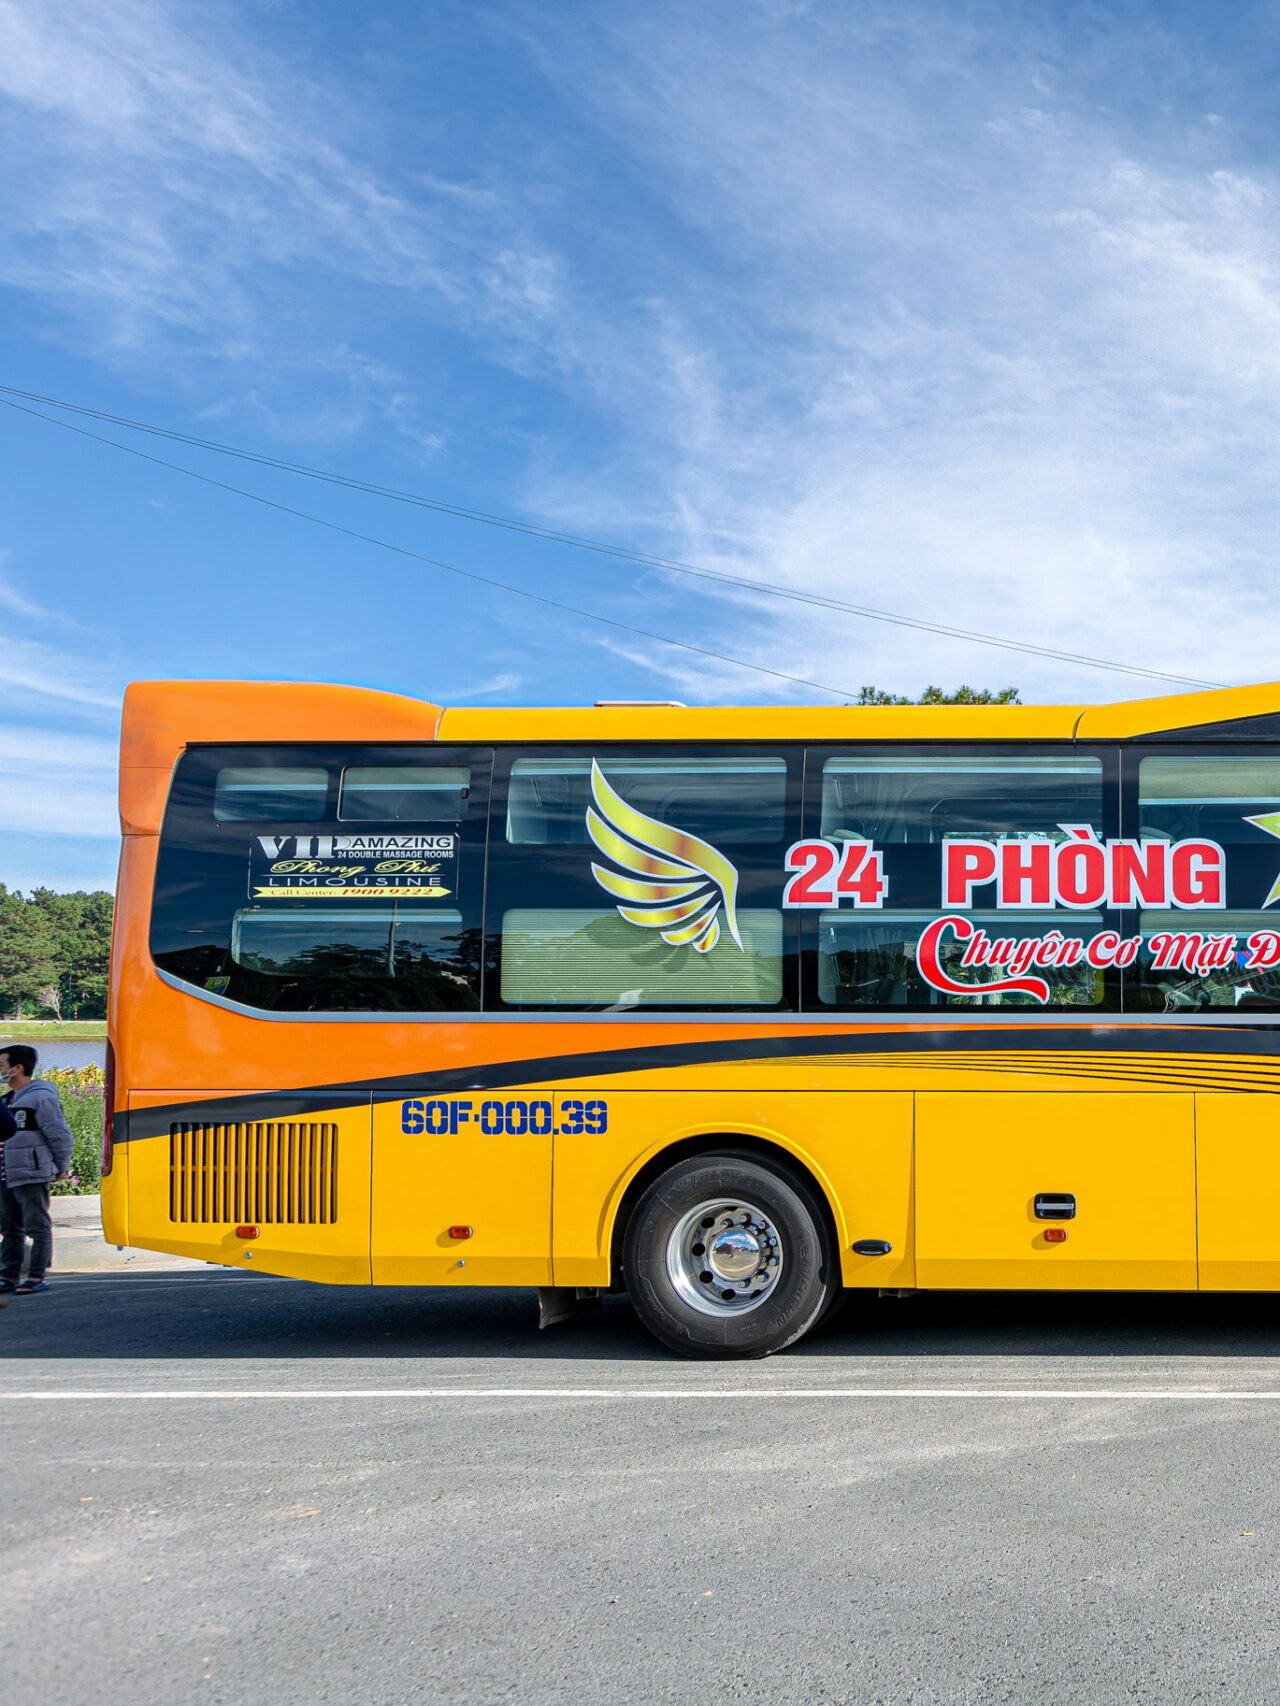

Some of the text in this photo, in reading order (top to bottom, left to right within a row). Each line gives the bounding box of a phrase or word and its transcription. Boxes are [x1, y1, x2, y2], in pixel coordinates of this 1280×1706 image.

[257, 835, 451, 859] VIP AMAZING
[383, 850, 423, 858] MASSAGE
[424, 850, 454, 858] ROOMS
[270, 860, 367, 878] Phong
[782, 838, 889, 910] 24
[940, 823, 1227, 910] PHÒNG
[269, 877, 441, 886] LIMOUSINE
[916, 914, 1088, 1004] Chuyên
[1086, 930, 1142, 969] Cơ
[1149, 932, 1238, 978] Mặt
